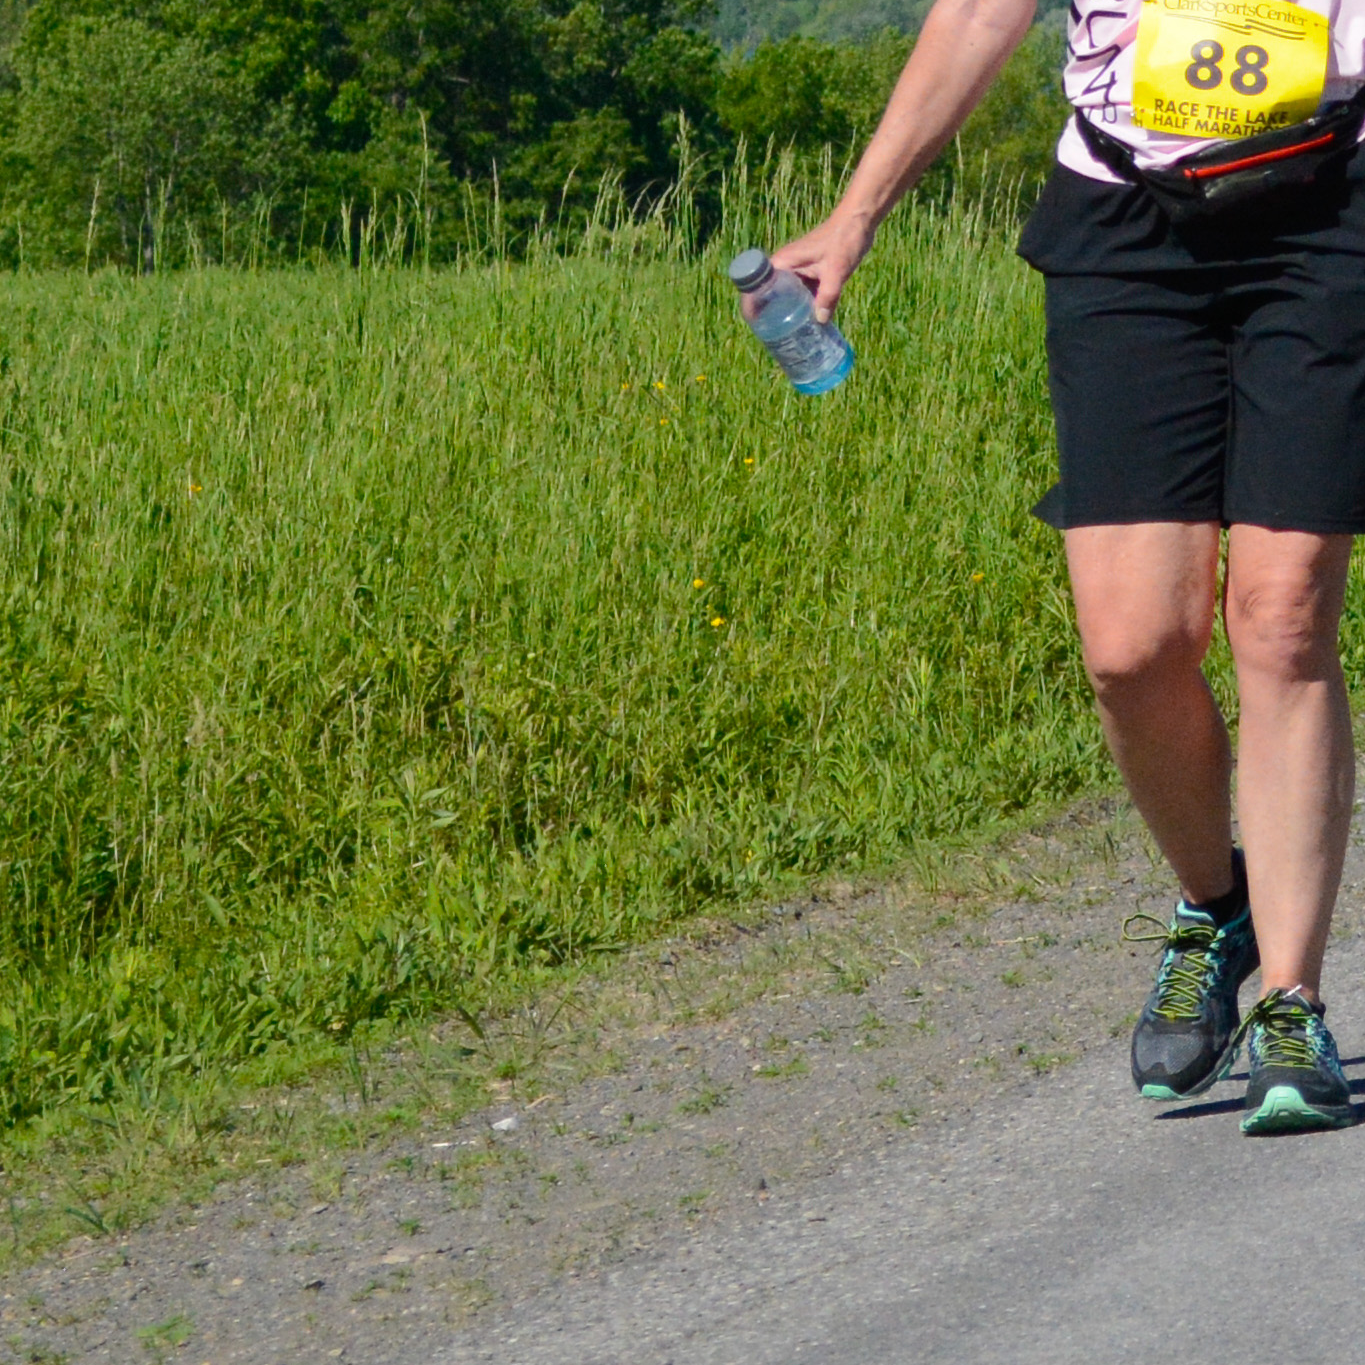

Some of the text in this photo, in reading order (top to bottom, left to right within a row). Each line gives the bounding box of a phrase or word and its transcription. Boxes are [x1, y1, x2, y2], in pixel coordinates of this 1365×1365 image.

[1184, 39, 1269, 96] 88
[1152, 113, 1190, 129] HALF
[1194, 120, 1283, 137] MARATHO
[1154, 98, 1289, 126] RACE THE LAKE
